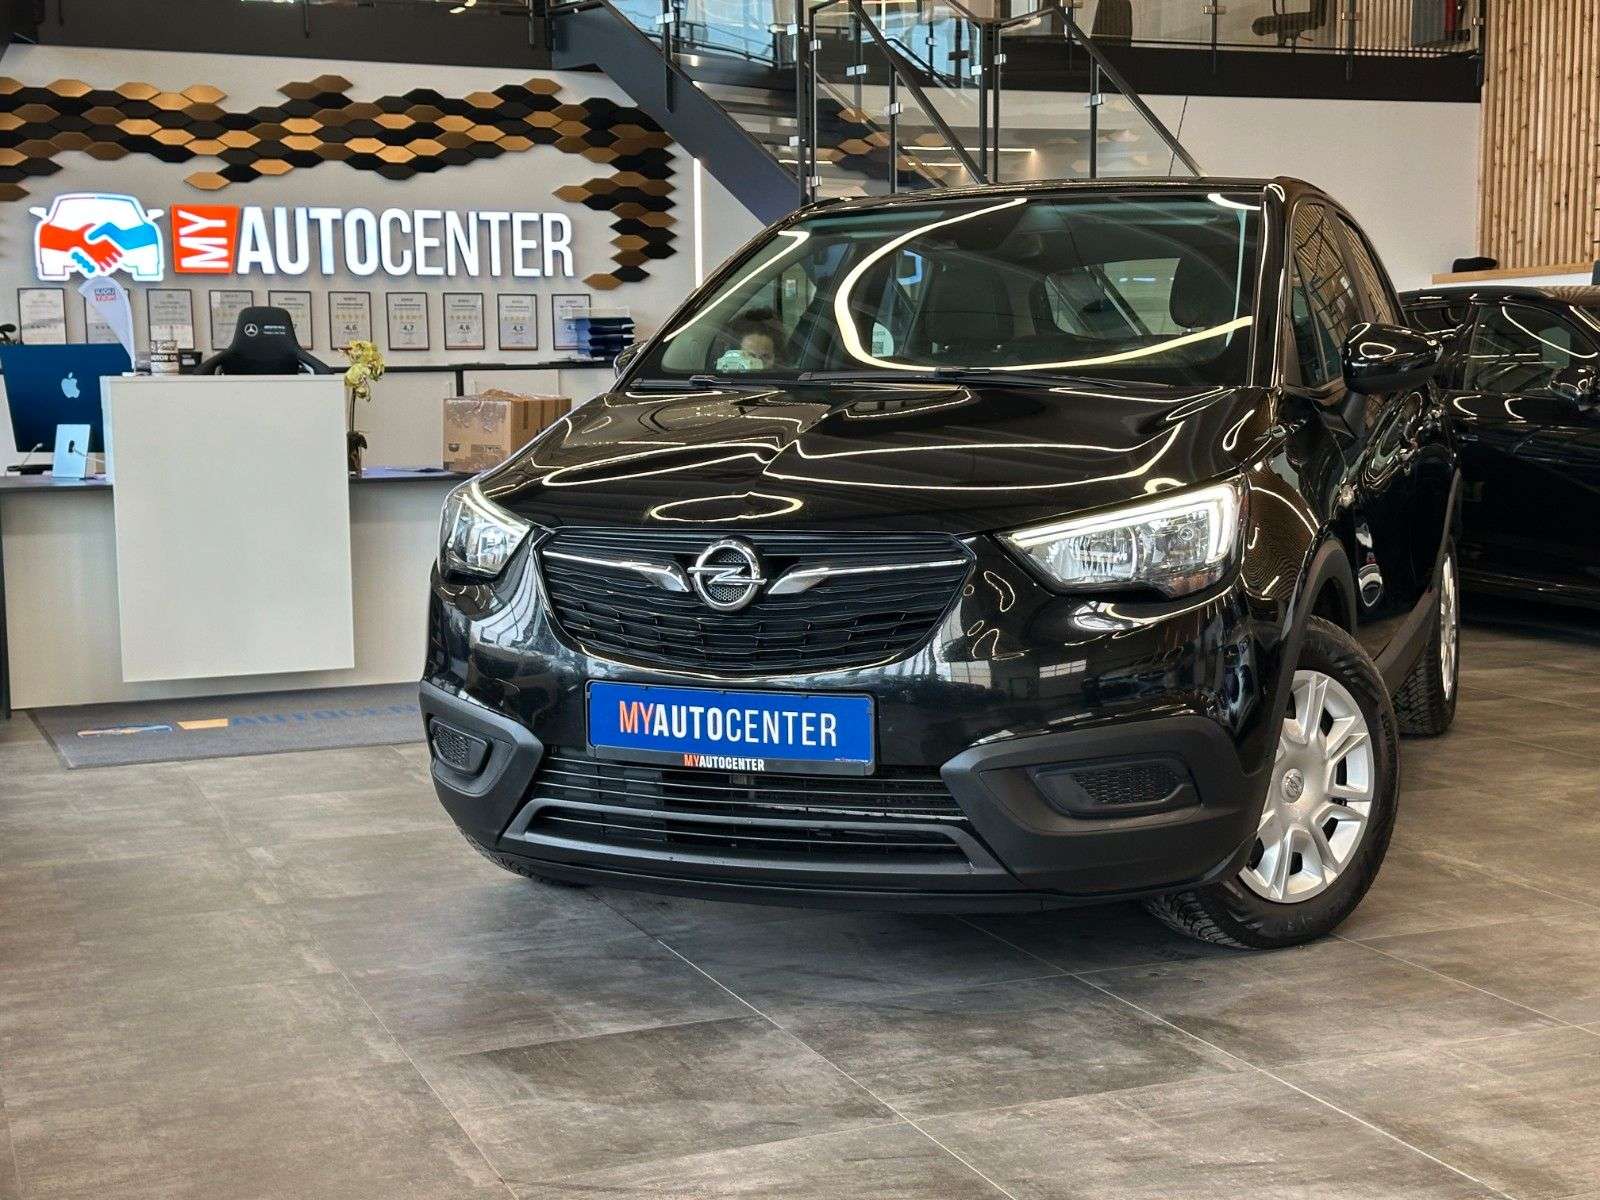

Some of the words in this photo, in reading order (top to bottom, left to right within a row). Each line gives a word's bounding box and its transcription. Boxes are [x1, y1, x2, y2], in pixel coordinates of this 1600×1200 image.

[178, 209, 230, 268] MY
[237, 207, 574, 277] AUTOCENTER
[619, 700, 838, 748] MYAUTOCENTER
[683, 752, 766, 772] MYAUTOCENTER
